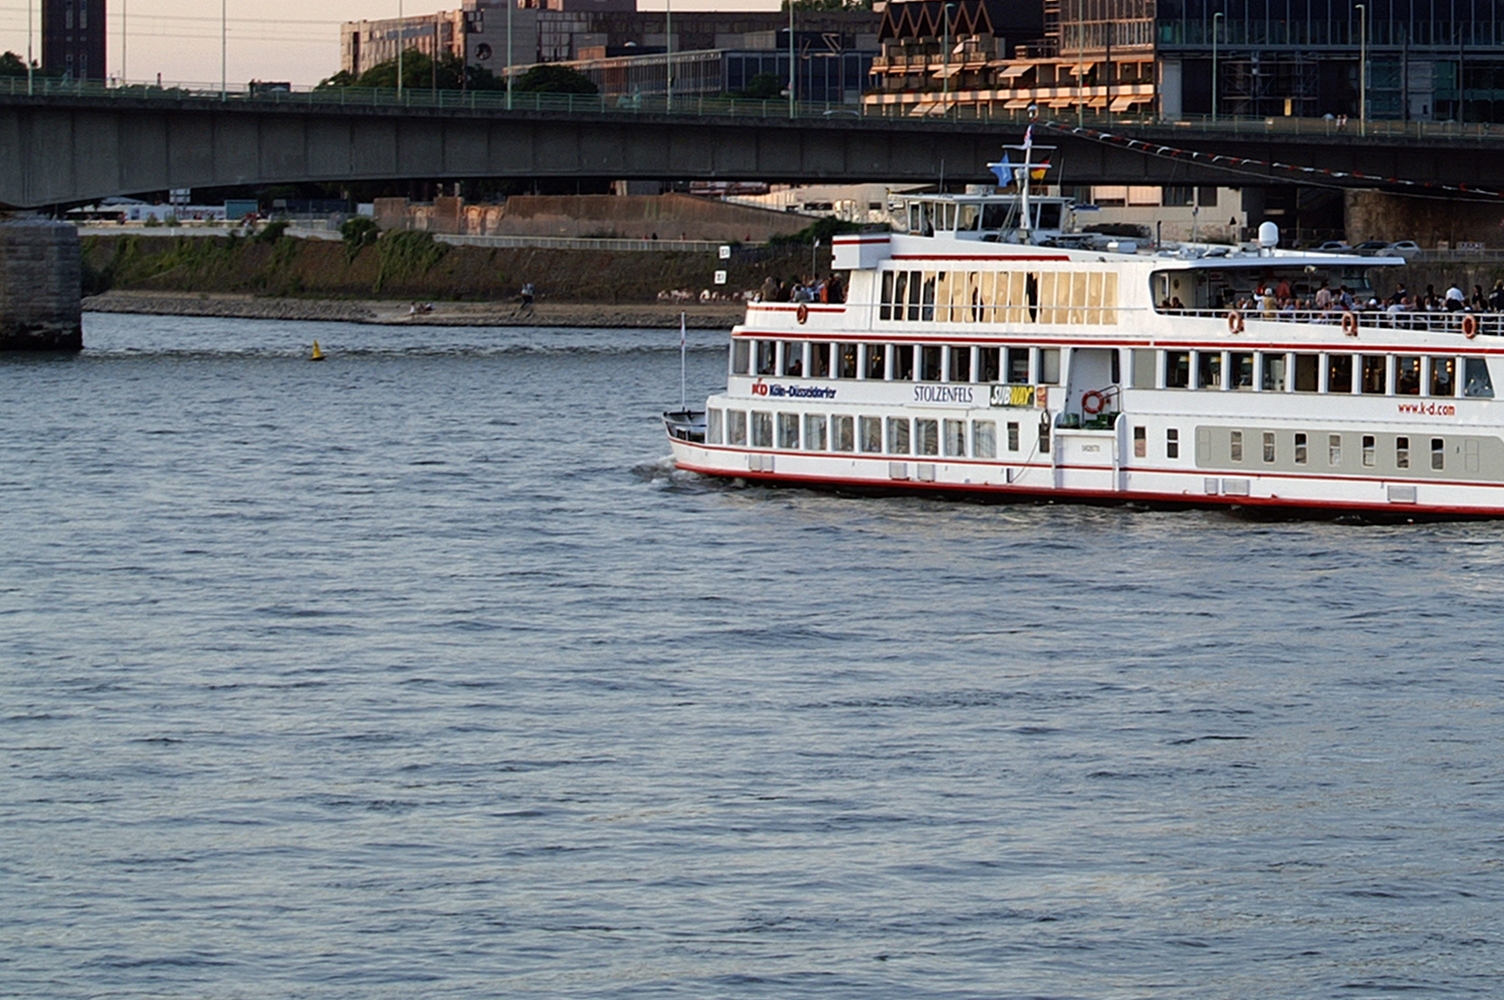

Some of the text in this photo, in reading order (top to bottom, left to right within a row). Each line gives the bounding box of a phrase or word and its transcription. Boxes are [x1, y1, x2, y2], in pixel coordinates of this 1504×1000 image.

[914, 385, 973, 403] STOLZENFELS
[991, 386, 1034, 405] SUBWAY
[1398, 402, 1456, 416] www.k-d.com
